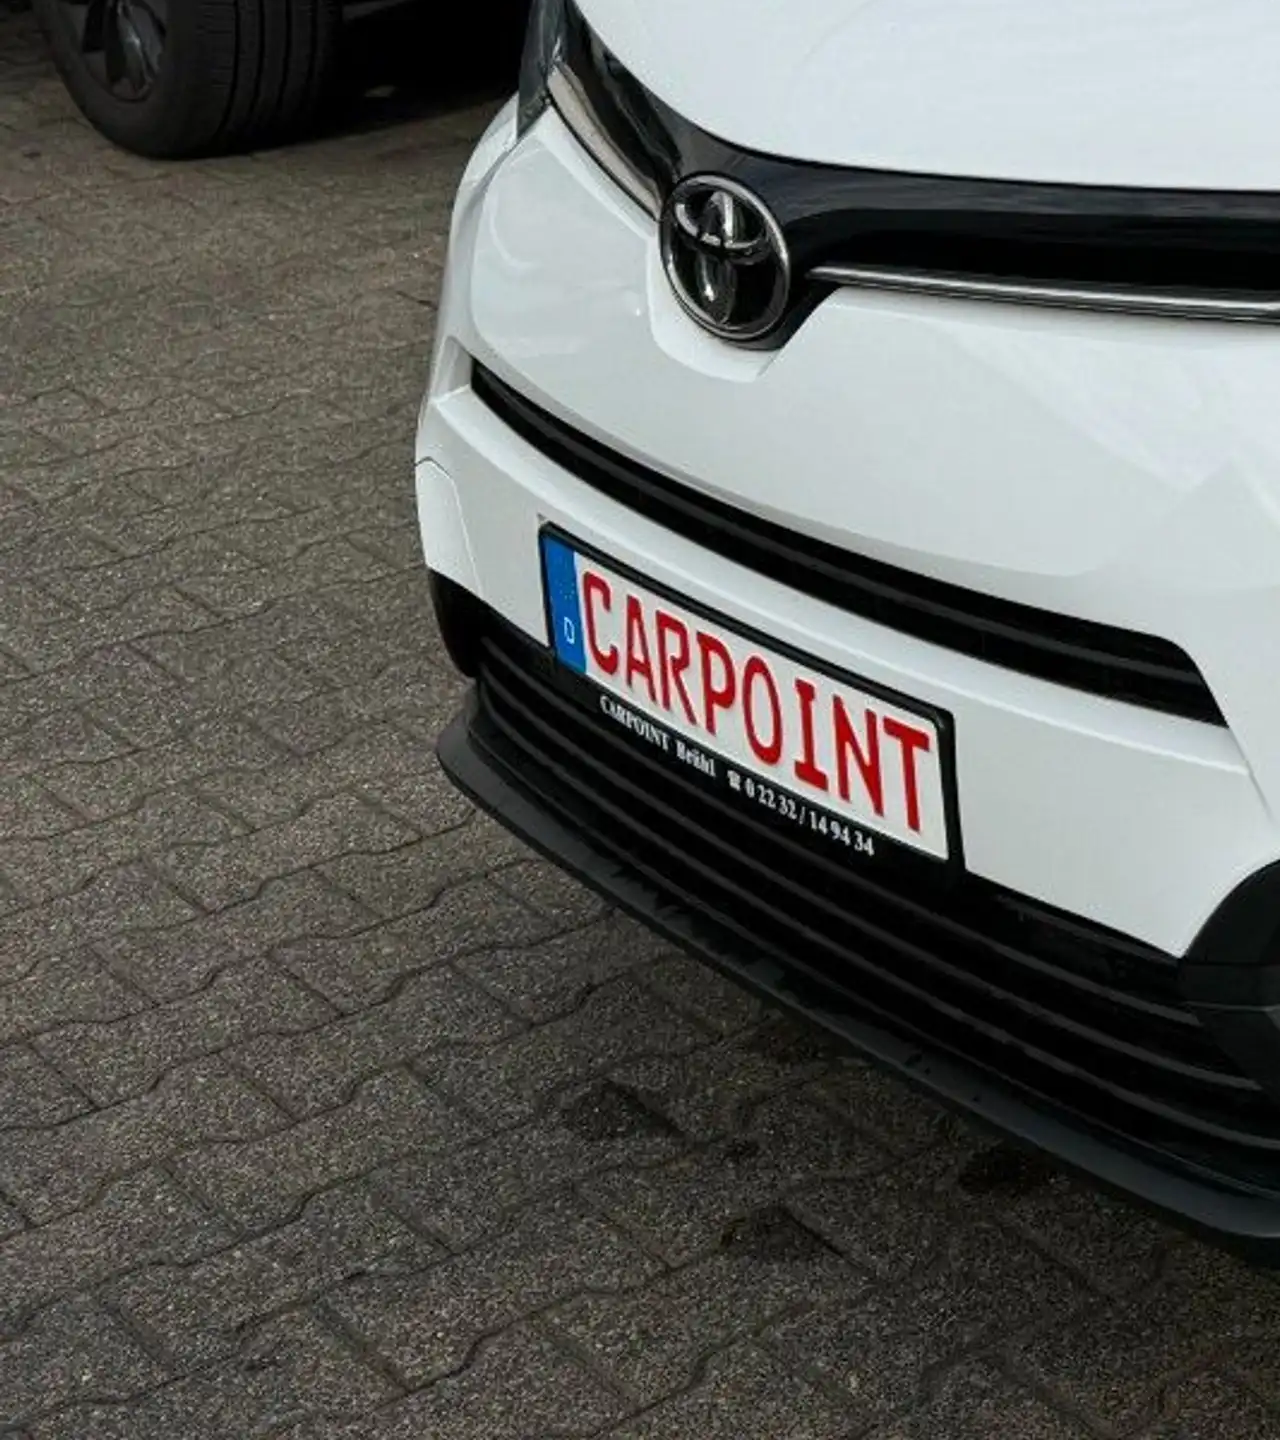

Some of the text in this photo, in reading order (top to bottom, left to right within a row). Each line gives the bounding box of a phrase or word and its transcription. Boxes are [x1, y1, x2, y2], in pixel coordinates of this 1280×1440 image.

[583, 571, 931, 834] CARPOINT
[600, 696, 669, 752] CARPOINT
[778, 795, 797, 820] 32
[810, 811, 828, 835] 14
[830, 821, 850, 846] 94
[854, 831, 875, 857] 34
